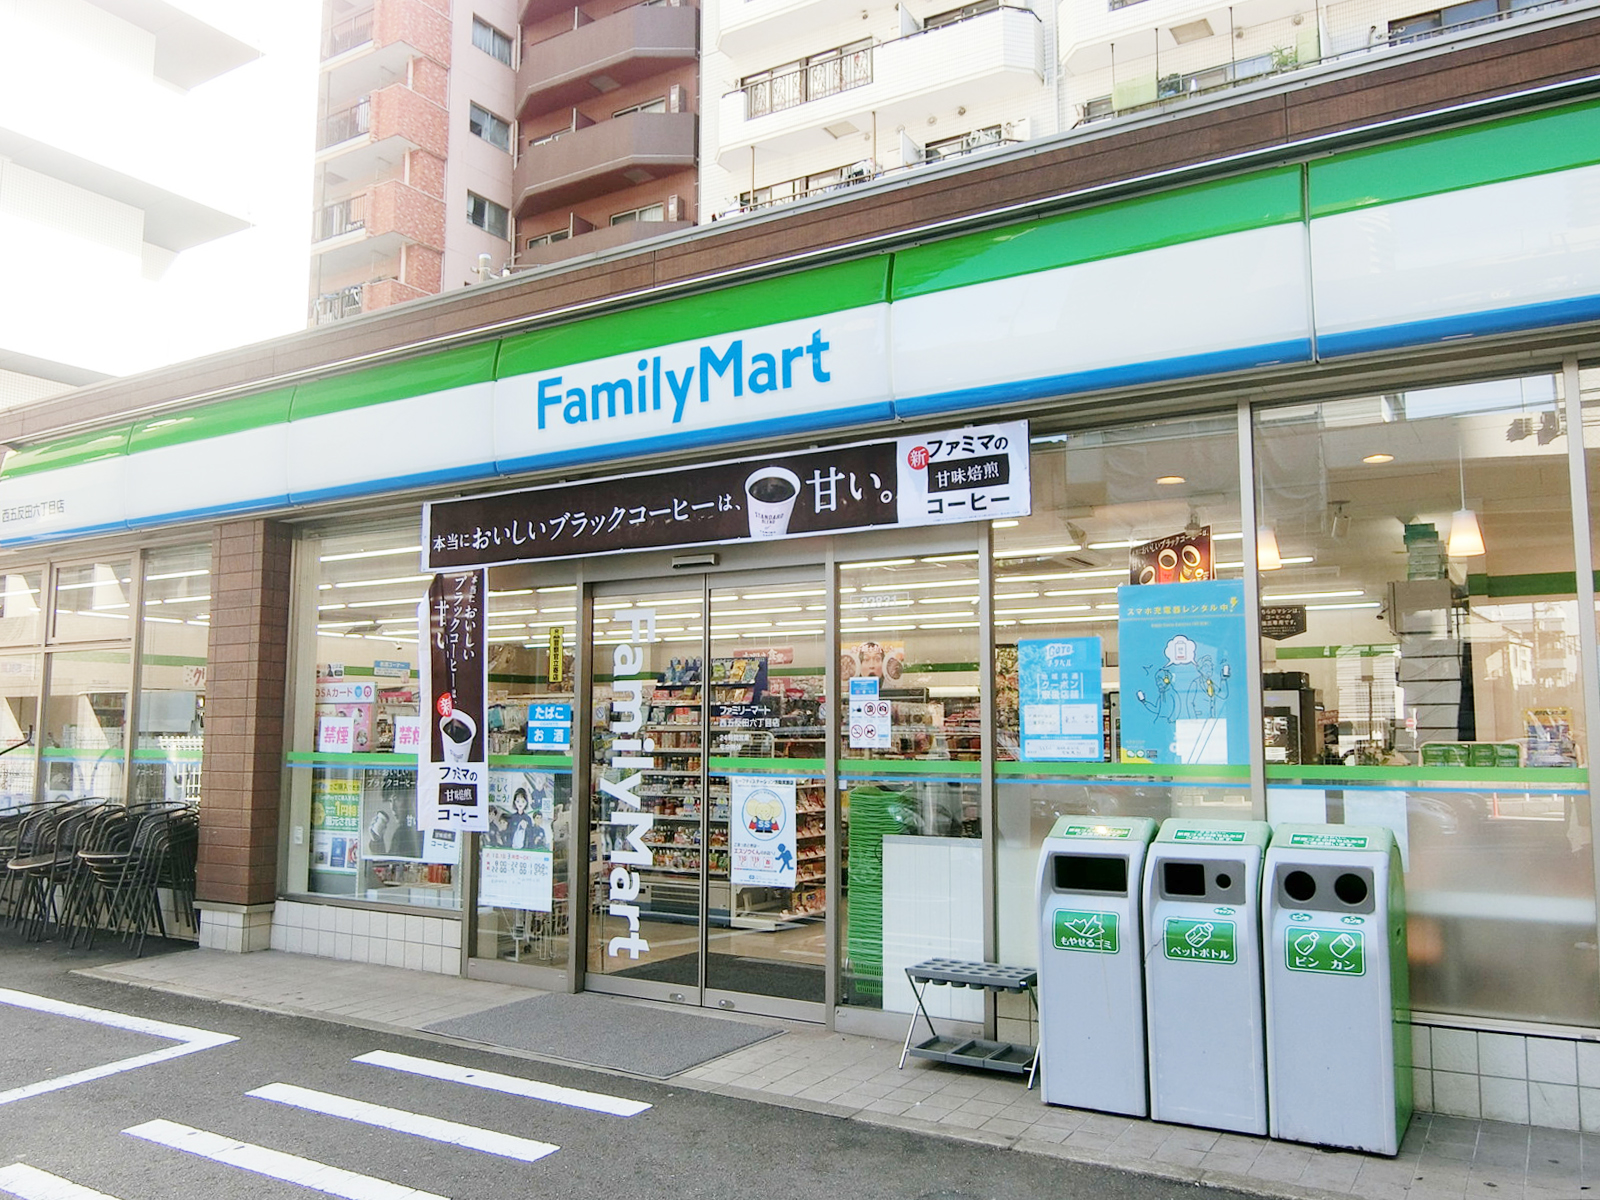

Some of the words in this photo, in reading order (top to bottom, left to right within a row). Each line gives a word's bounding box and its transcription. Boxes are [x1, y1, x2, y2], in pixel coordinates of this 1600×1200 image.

[537, 328, 831, 430] FamilyMart
[909, 448, 927, 467] 新
[928, 433, 1009, 458] ファミマの
[935, 460, 1000, 488] 甘味焙煎
[2, 499, 65, 523] 西五反田六丁目店
[433, 493, 741, 552] 本当においしいブラックコーヒーは、
[805, 466, 893, 514] 甘い。
[928, 493, 1010, 514] コーヒー
[1041, 679, 1079, 690] クーポン
[535, 705, 565, 719] たばこ
[719, 705, 771, 715] ファミリーマート
[719, 718, 780, 727] 西五反田六丁目店
[324, 725, 349, 744] 禁煙
[600, 607, 656, 960] FamilyMart
[438, 808, 478, 823] コーヒー
[431, 840, 455, 850] コーヒー
[1060, 935, 1112, 950] もやせるゴミ
[1170, 946, 1230, 960] ペットボトル
[1295, 956, 1319, 967] ビン
[1331, 959, 1356, 971] カン
